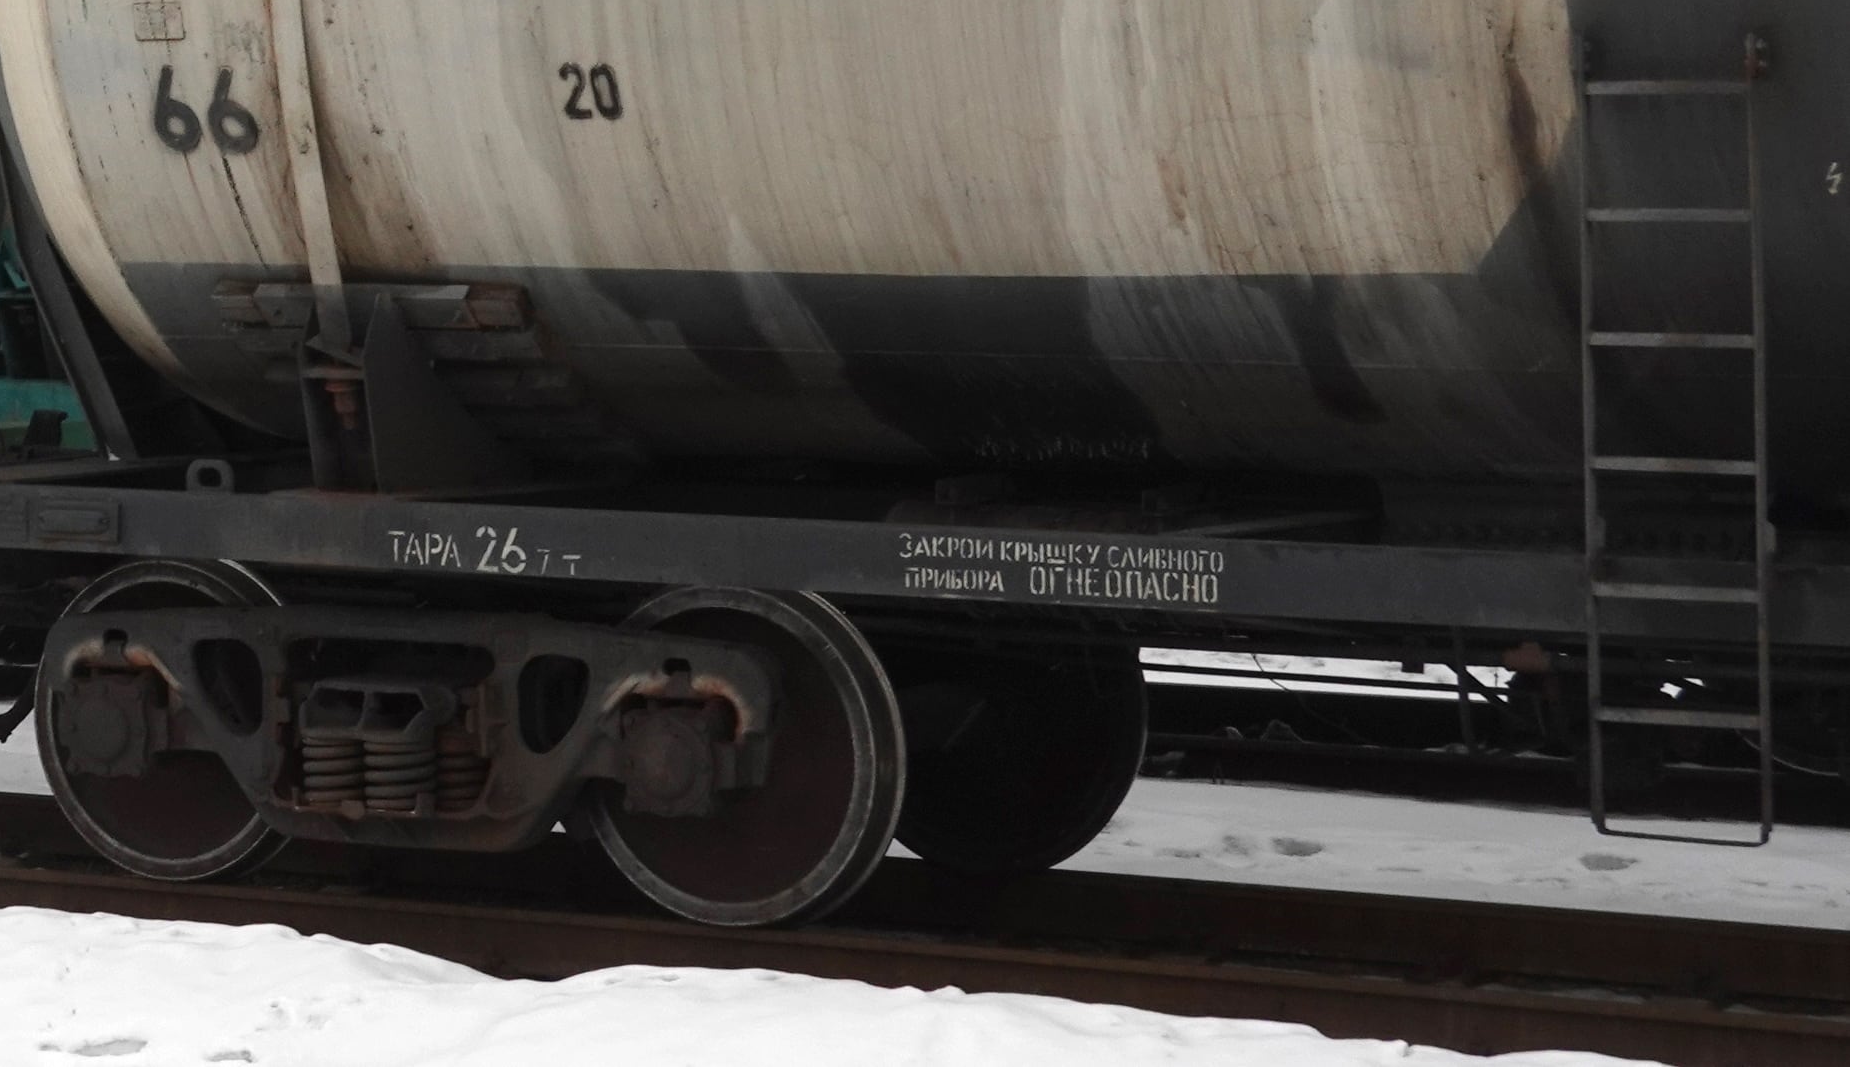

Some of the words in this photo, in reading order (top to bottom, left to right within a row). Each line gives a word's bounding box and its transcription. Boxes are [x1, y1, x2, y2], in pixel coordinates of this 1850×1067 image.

[153, 64, 260, 156] 66
[559, 62, 624, 121] 20
[387, 530, 462, 568] ТАРА
[475, 525, 527, 574] 26
[1000, 540, 1100, 565] КРЫШКУ
[1107, 545, 1225, 573] СЛИВНОГО
[904, 566, 1005, 592] ПРИБОРА
